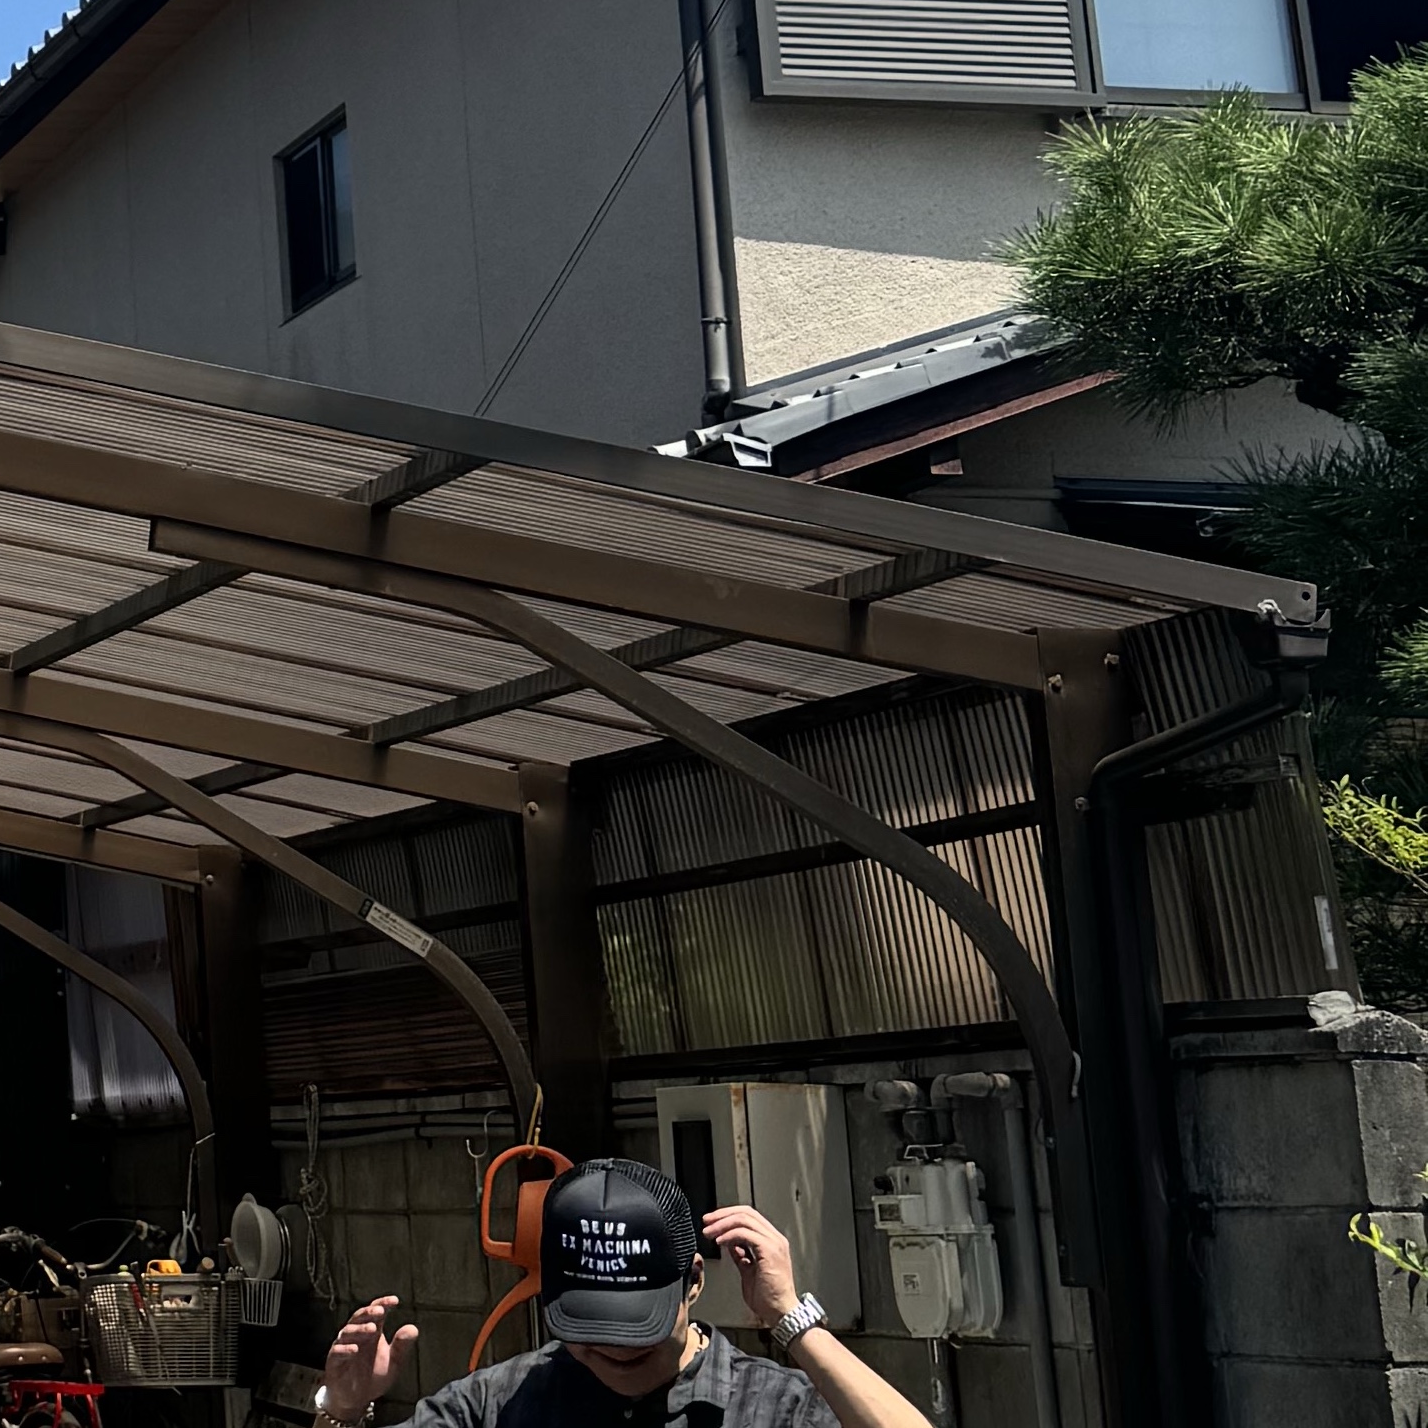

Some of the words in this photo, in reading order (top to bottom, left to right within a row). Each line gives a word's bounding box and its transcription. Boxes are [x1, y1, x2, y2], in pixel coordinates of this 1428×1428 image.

[580, 1218, 627, 1237] DEUS
[561, 1233, 576, 1250] EX
[582, 1238, 651, 1256] MACHINA
[580, 1253, 628, 1273] VENICE
